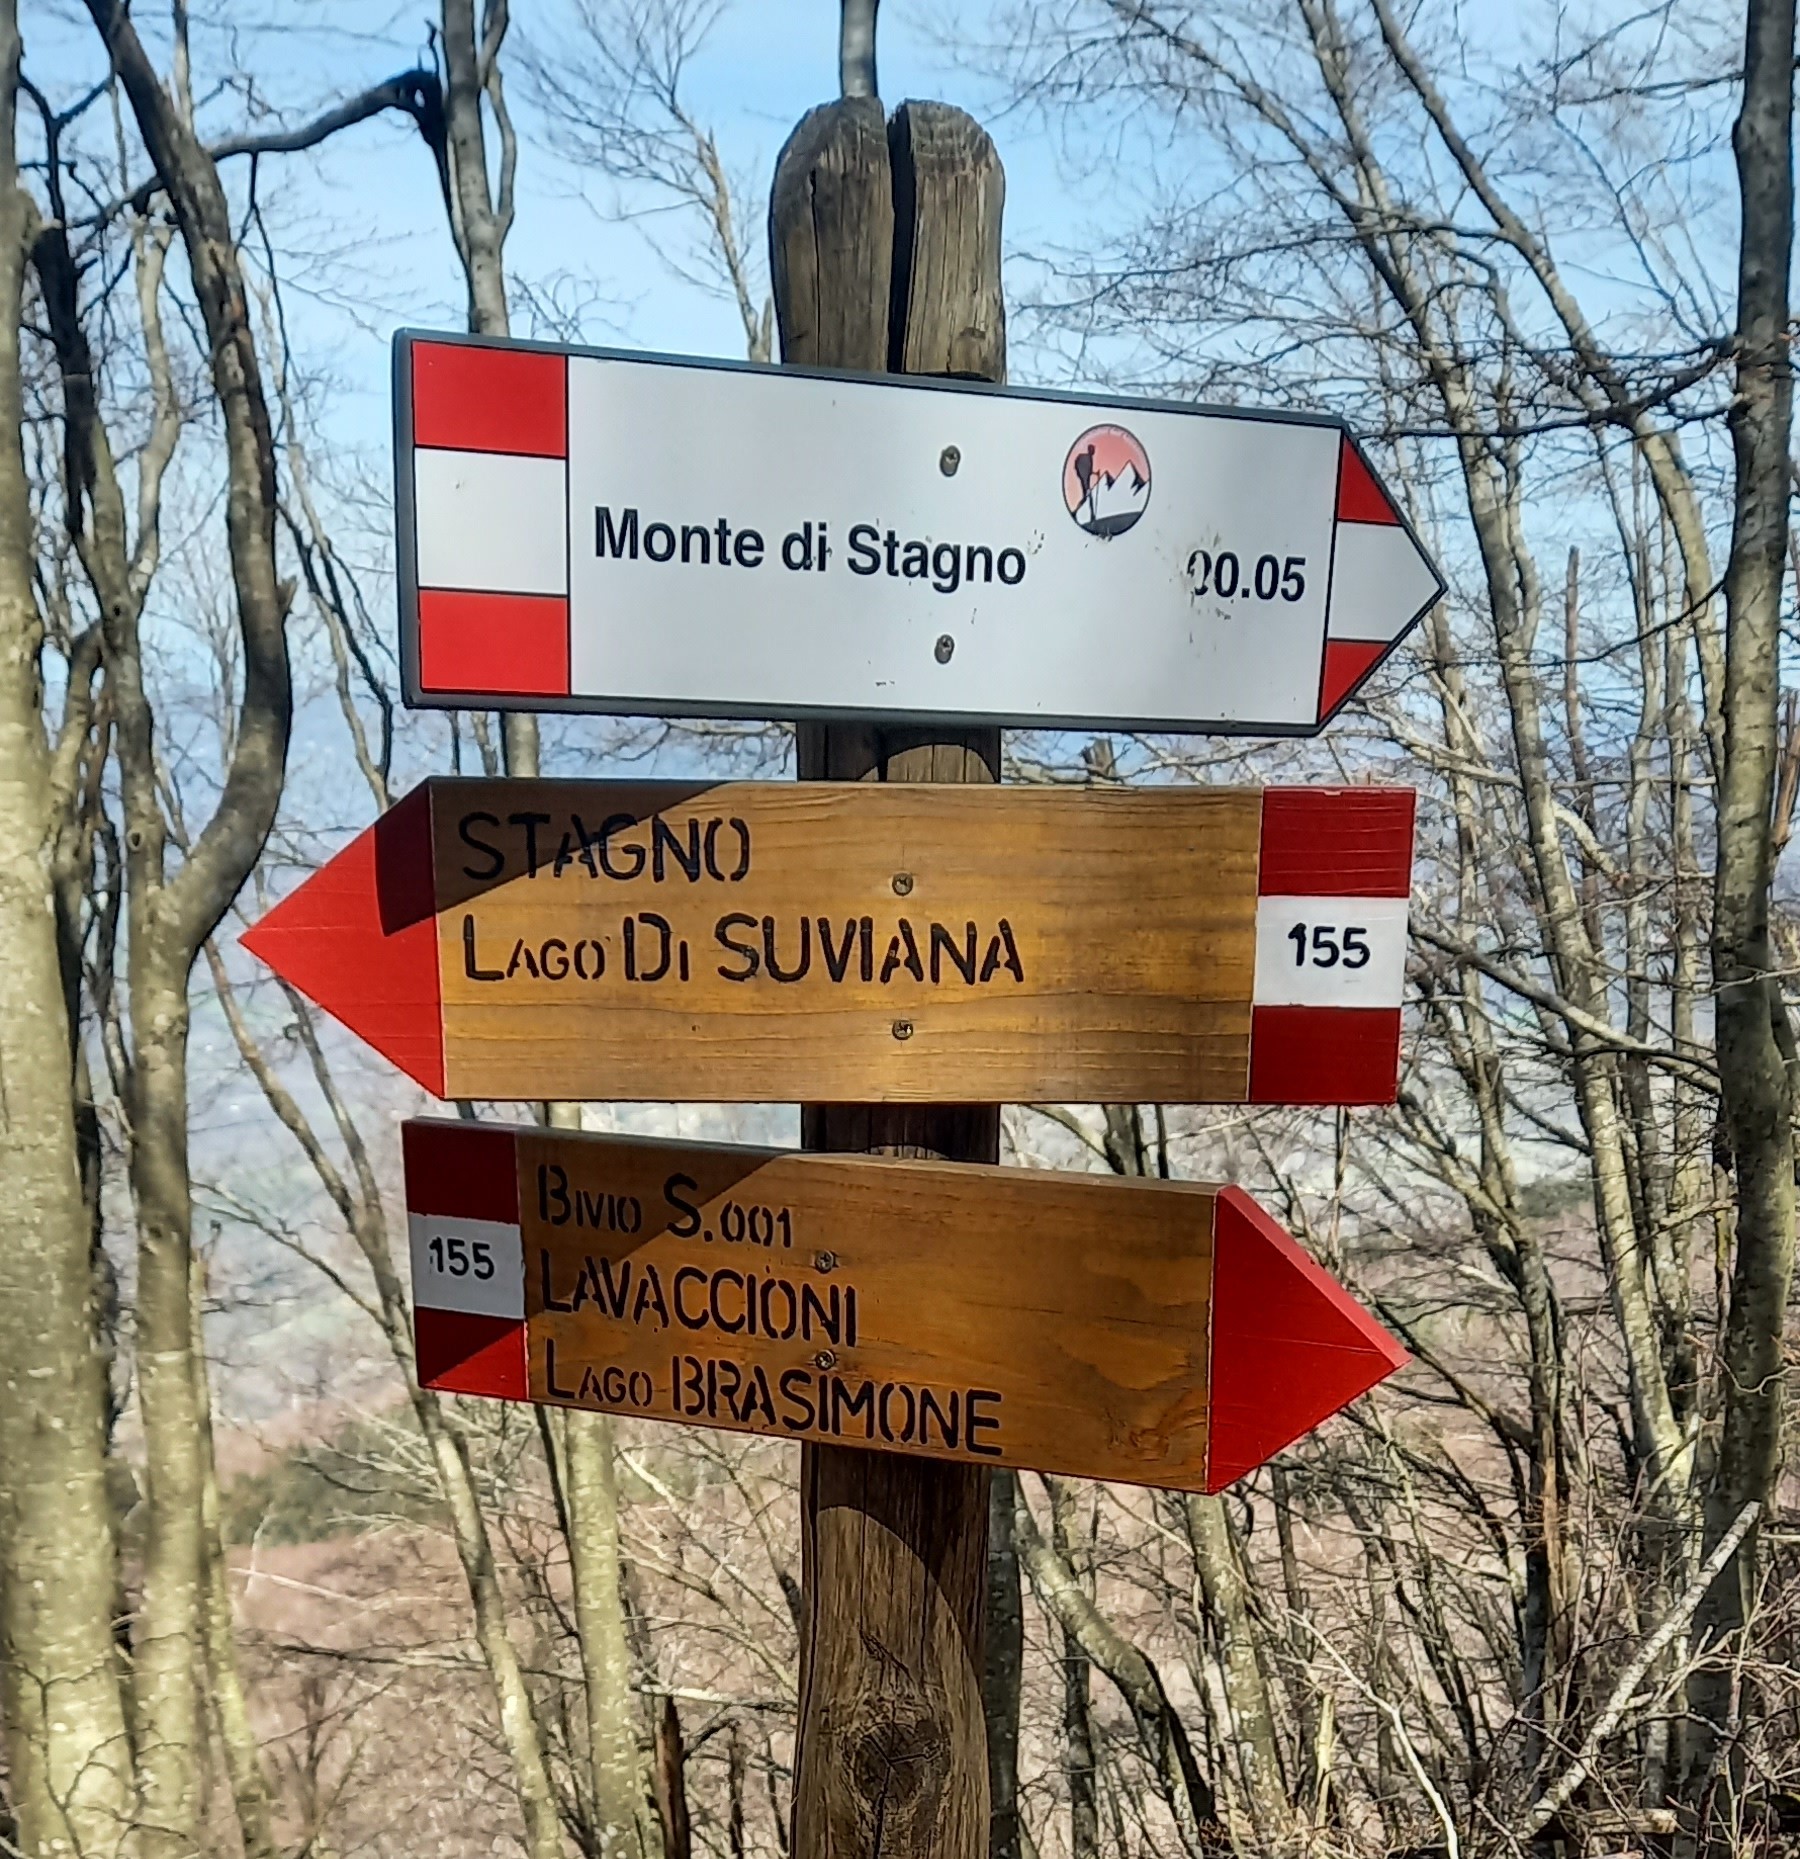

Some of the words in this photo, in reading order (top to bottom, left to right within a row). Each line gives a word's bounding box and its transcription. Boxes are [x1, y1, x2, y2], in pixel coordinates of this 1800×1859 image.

[594, 505, 765, 568] Monte
[781, 521, 829, 574] di
[848, 524, 1027, 592] Stagno
[1187, 550, 1306, 602] 00.05
[458, 811, 750, 883] STAGNO
[714, 913, 1024, 985] SUVIANA
[1288, 923, 1370, 969] 155
[663, 1173, 792, 1248] S.001
[429, 1236, 495, 1280] 155
[540, 1249, 859, 1347] LAVACCIONI
[672, 1355, 1003, 1456] BRASIMONE
